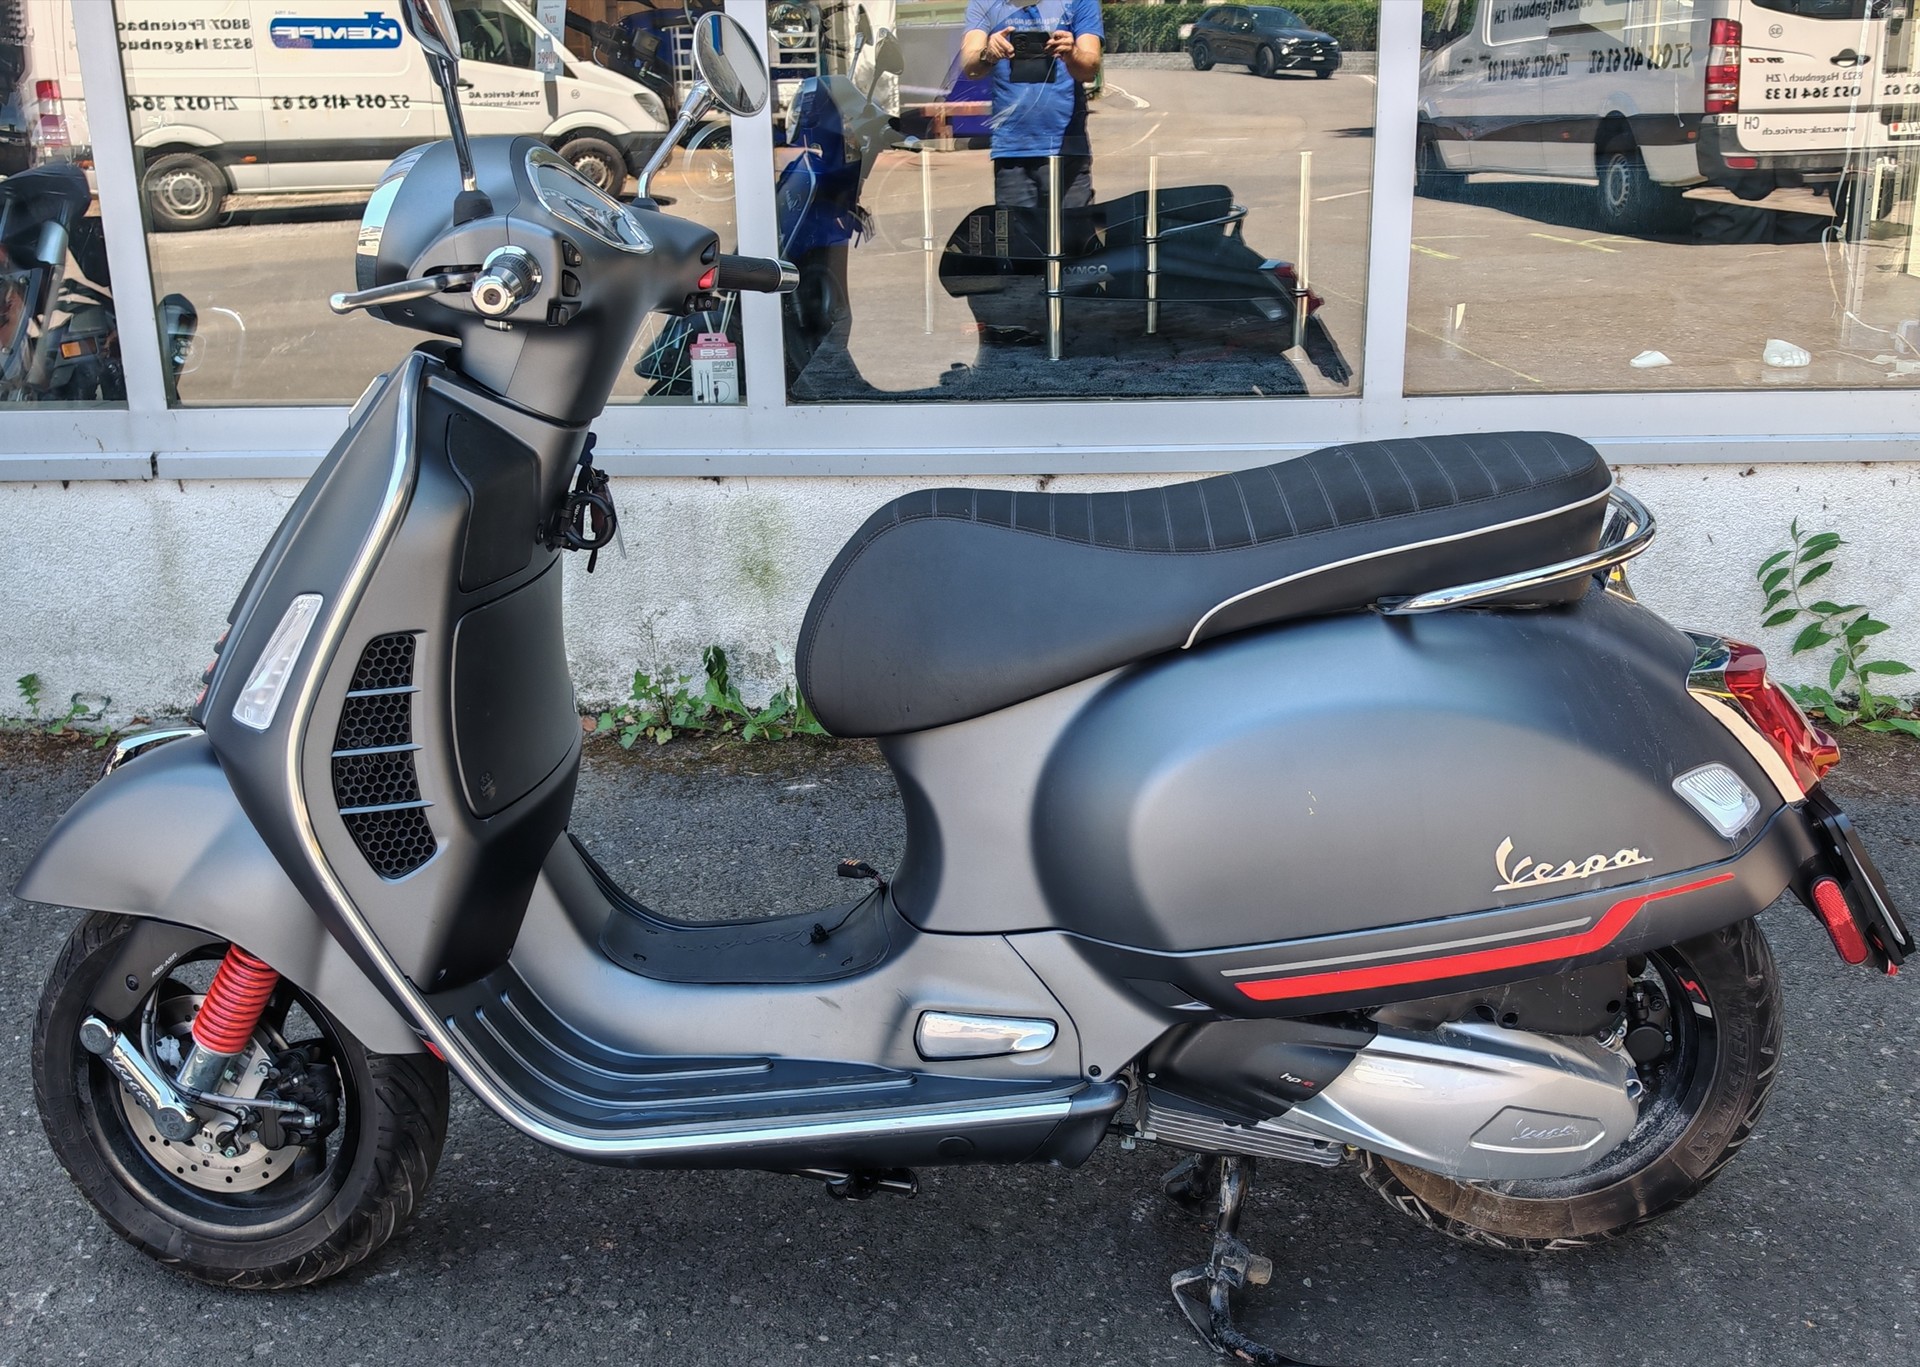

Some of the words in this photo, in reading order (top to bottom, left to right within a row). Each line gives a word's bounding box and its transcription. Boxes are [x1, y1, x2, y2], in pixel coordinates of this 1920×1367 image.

[700, 348, 729, 357] BS
[1492, 836, 1653, 892] Vespa
[1511, 1118, 1580, 1141] Vespa
